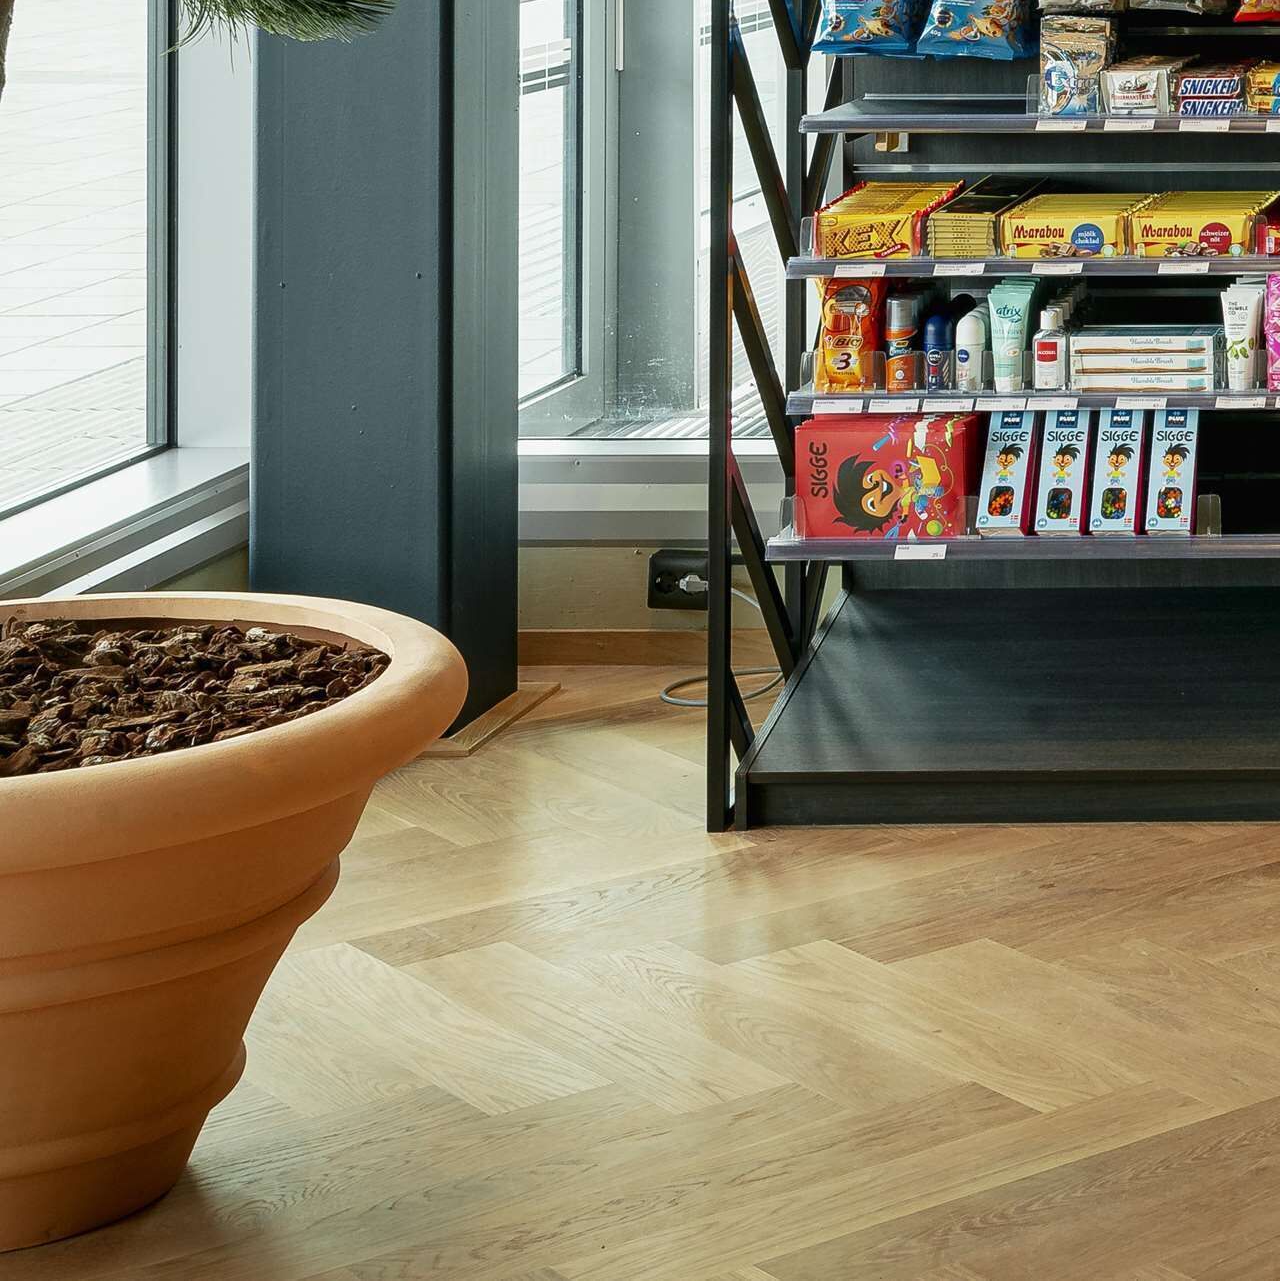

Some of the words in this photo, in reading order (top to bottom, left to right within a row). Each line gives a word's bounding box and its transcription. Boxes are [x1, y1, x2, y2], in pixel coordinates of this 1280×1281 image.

[1180, 79, 1239, 96] SNICKER
[1014, 225, 1065, 239] Marabou
[1142, 224, 1193, 238] Marabou
[826, 220, 900, 258] KEX
[996, 304, 1023, 317] atrix
[834, 337, 861, 348] BIC
[836, 353, 852, 370] 3
[991, 431, 1029, 442] SIGGE
[1047, 431, 1084, 442] SIGGE
[1101, 431, 1139, 442] SIGGE
[1156, 431, 1194, 442] SIGGE
[809, 441, 829, 498] SIGGE
